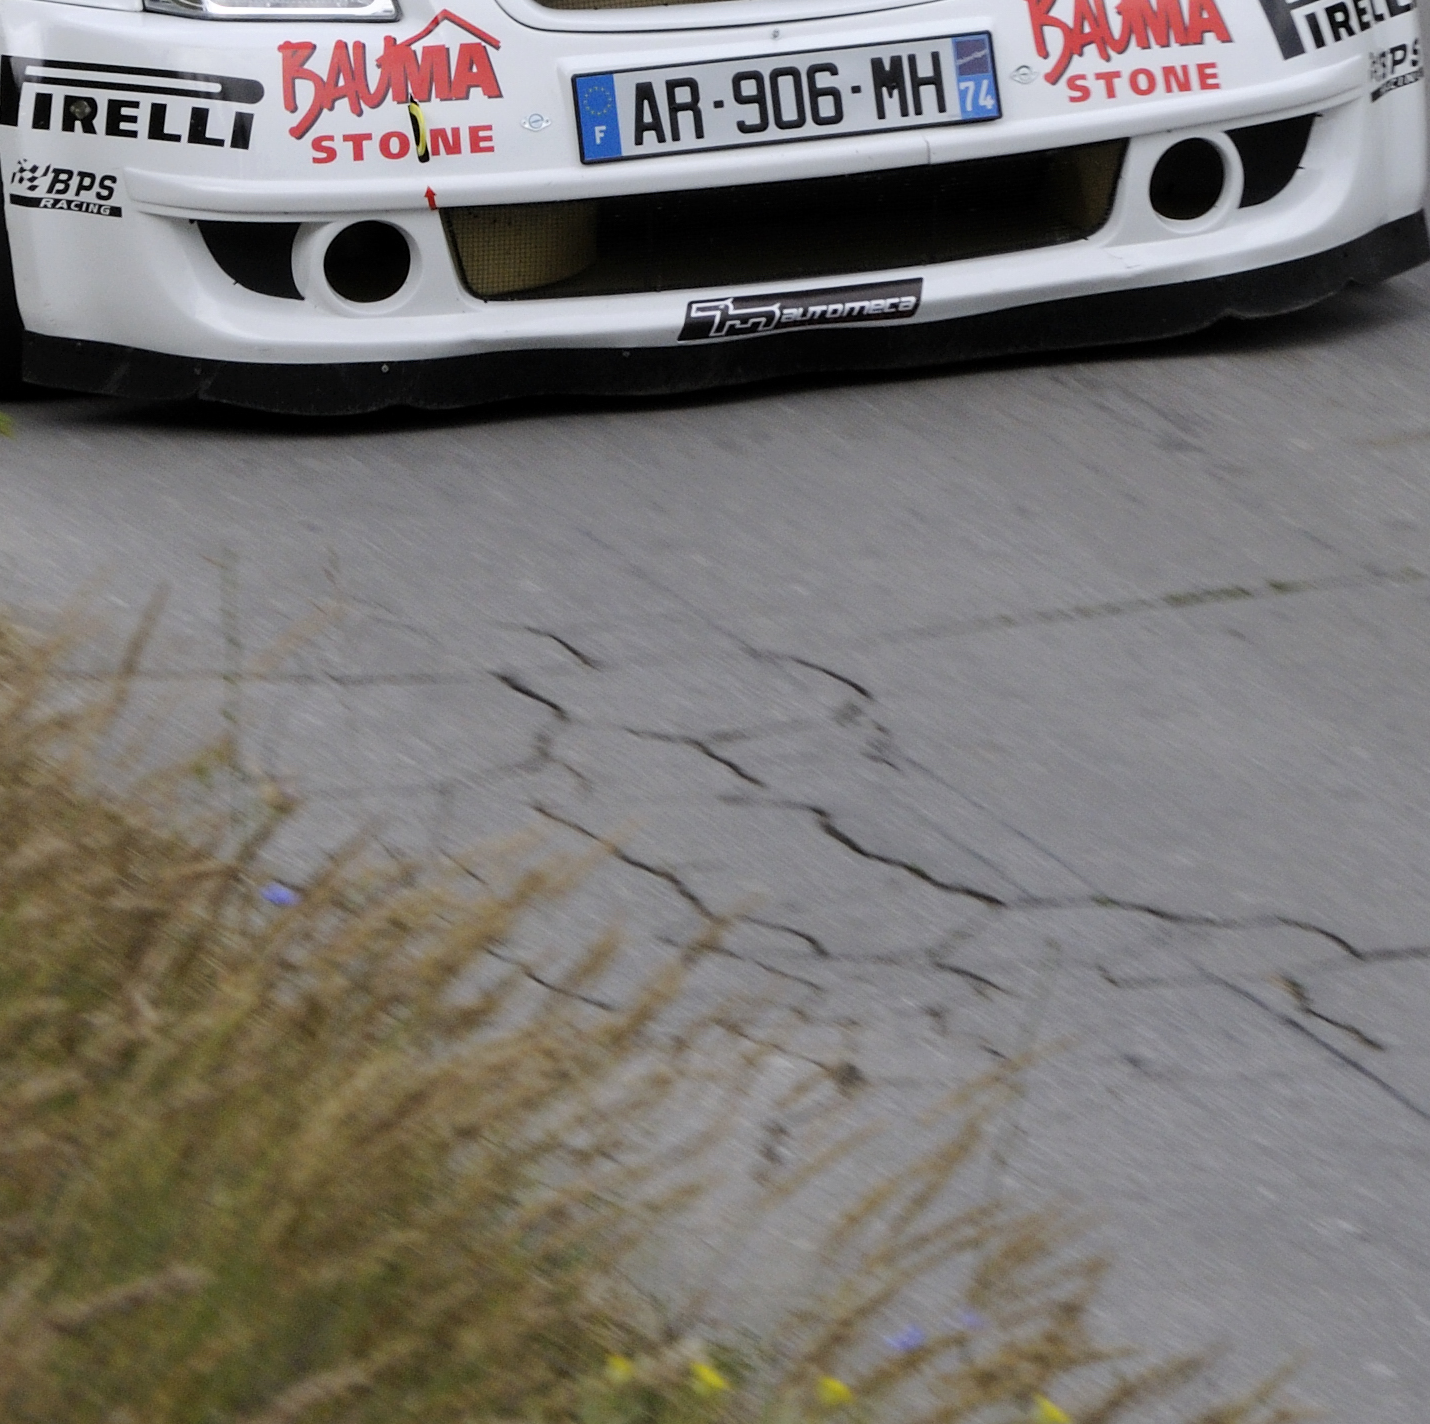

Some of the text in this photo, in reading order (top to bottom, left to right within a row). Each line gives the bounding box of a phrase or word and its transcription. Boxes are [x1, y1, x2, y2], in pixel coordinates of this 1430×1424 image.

[0, 54, 265, 151] PIRELLI
[277, 26, 504, 140] BAUMA
[1066, 62, 1221, 103] STONE
[594, 125, 607, 145] F
[959, 79, 995, 112] 74
[311, 124, 495, 165] STONE
[46, 168, 117, 201] BPS
[39, 197, 111, 216] RACING
